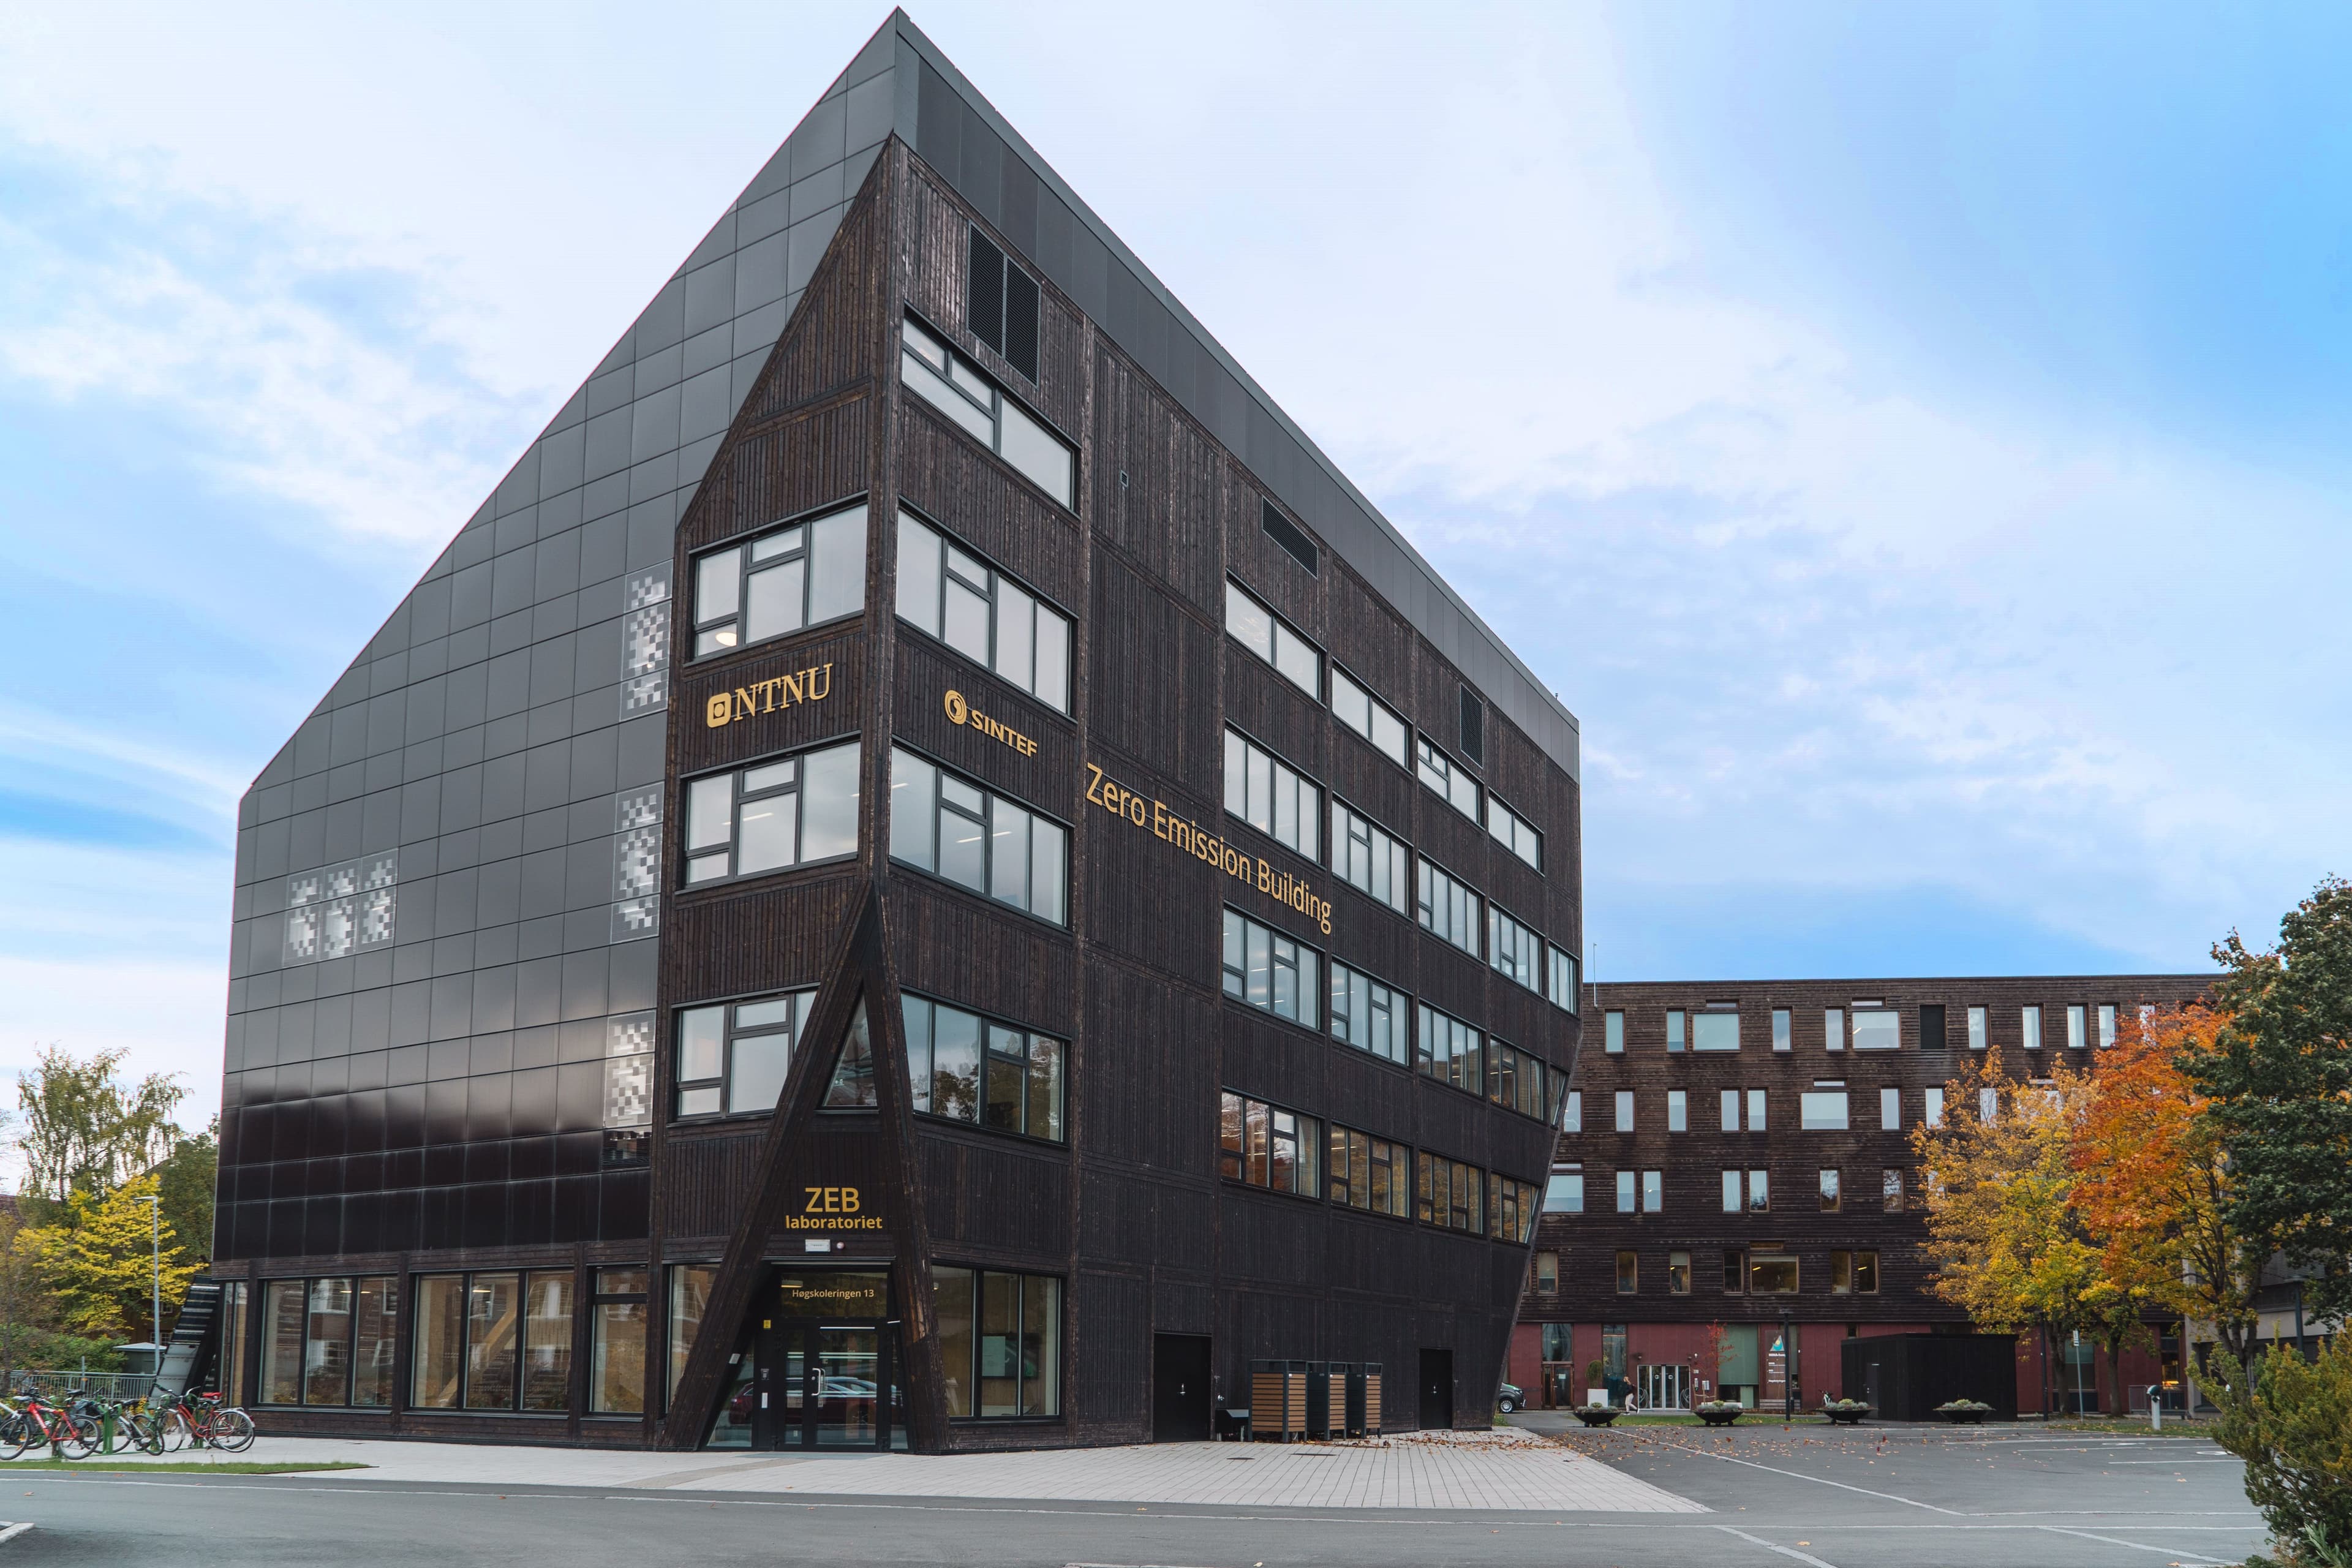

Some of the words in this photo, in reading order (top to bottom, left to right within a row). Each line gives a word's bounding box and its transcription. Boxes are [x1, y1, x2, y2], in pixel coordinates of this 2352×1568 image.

[734, 663, 833, 722] NTNU
[971, 709, 1038, 757] SINTEF
[1086, 762, 1146, 827] Zero
[1154, 800, 1251, 884] Emission
[1257, 858, 1332, 935] Building
[805, 1187, 861, 1213] ZEB
[786, 1215, 883, 1229] laboratoriet
[792, 1289, 861, 1300] Høgskoleringen
[864, 1289, 875, 1297] 13
